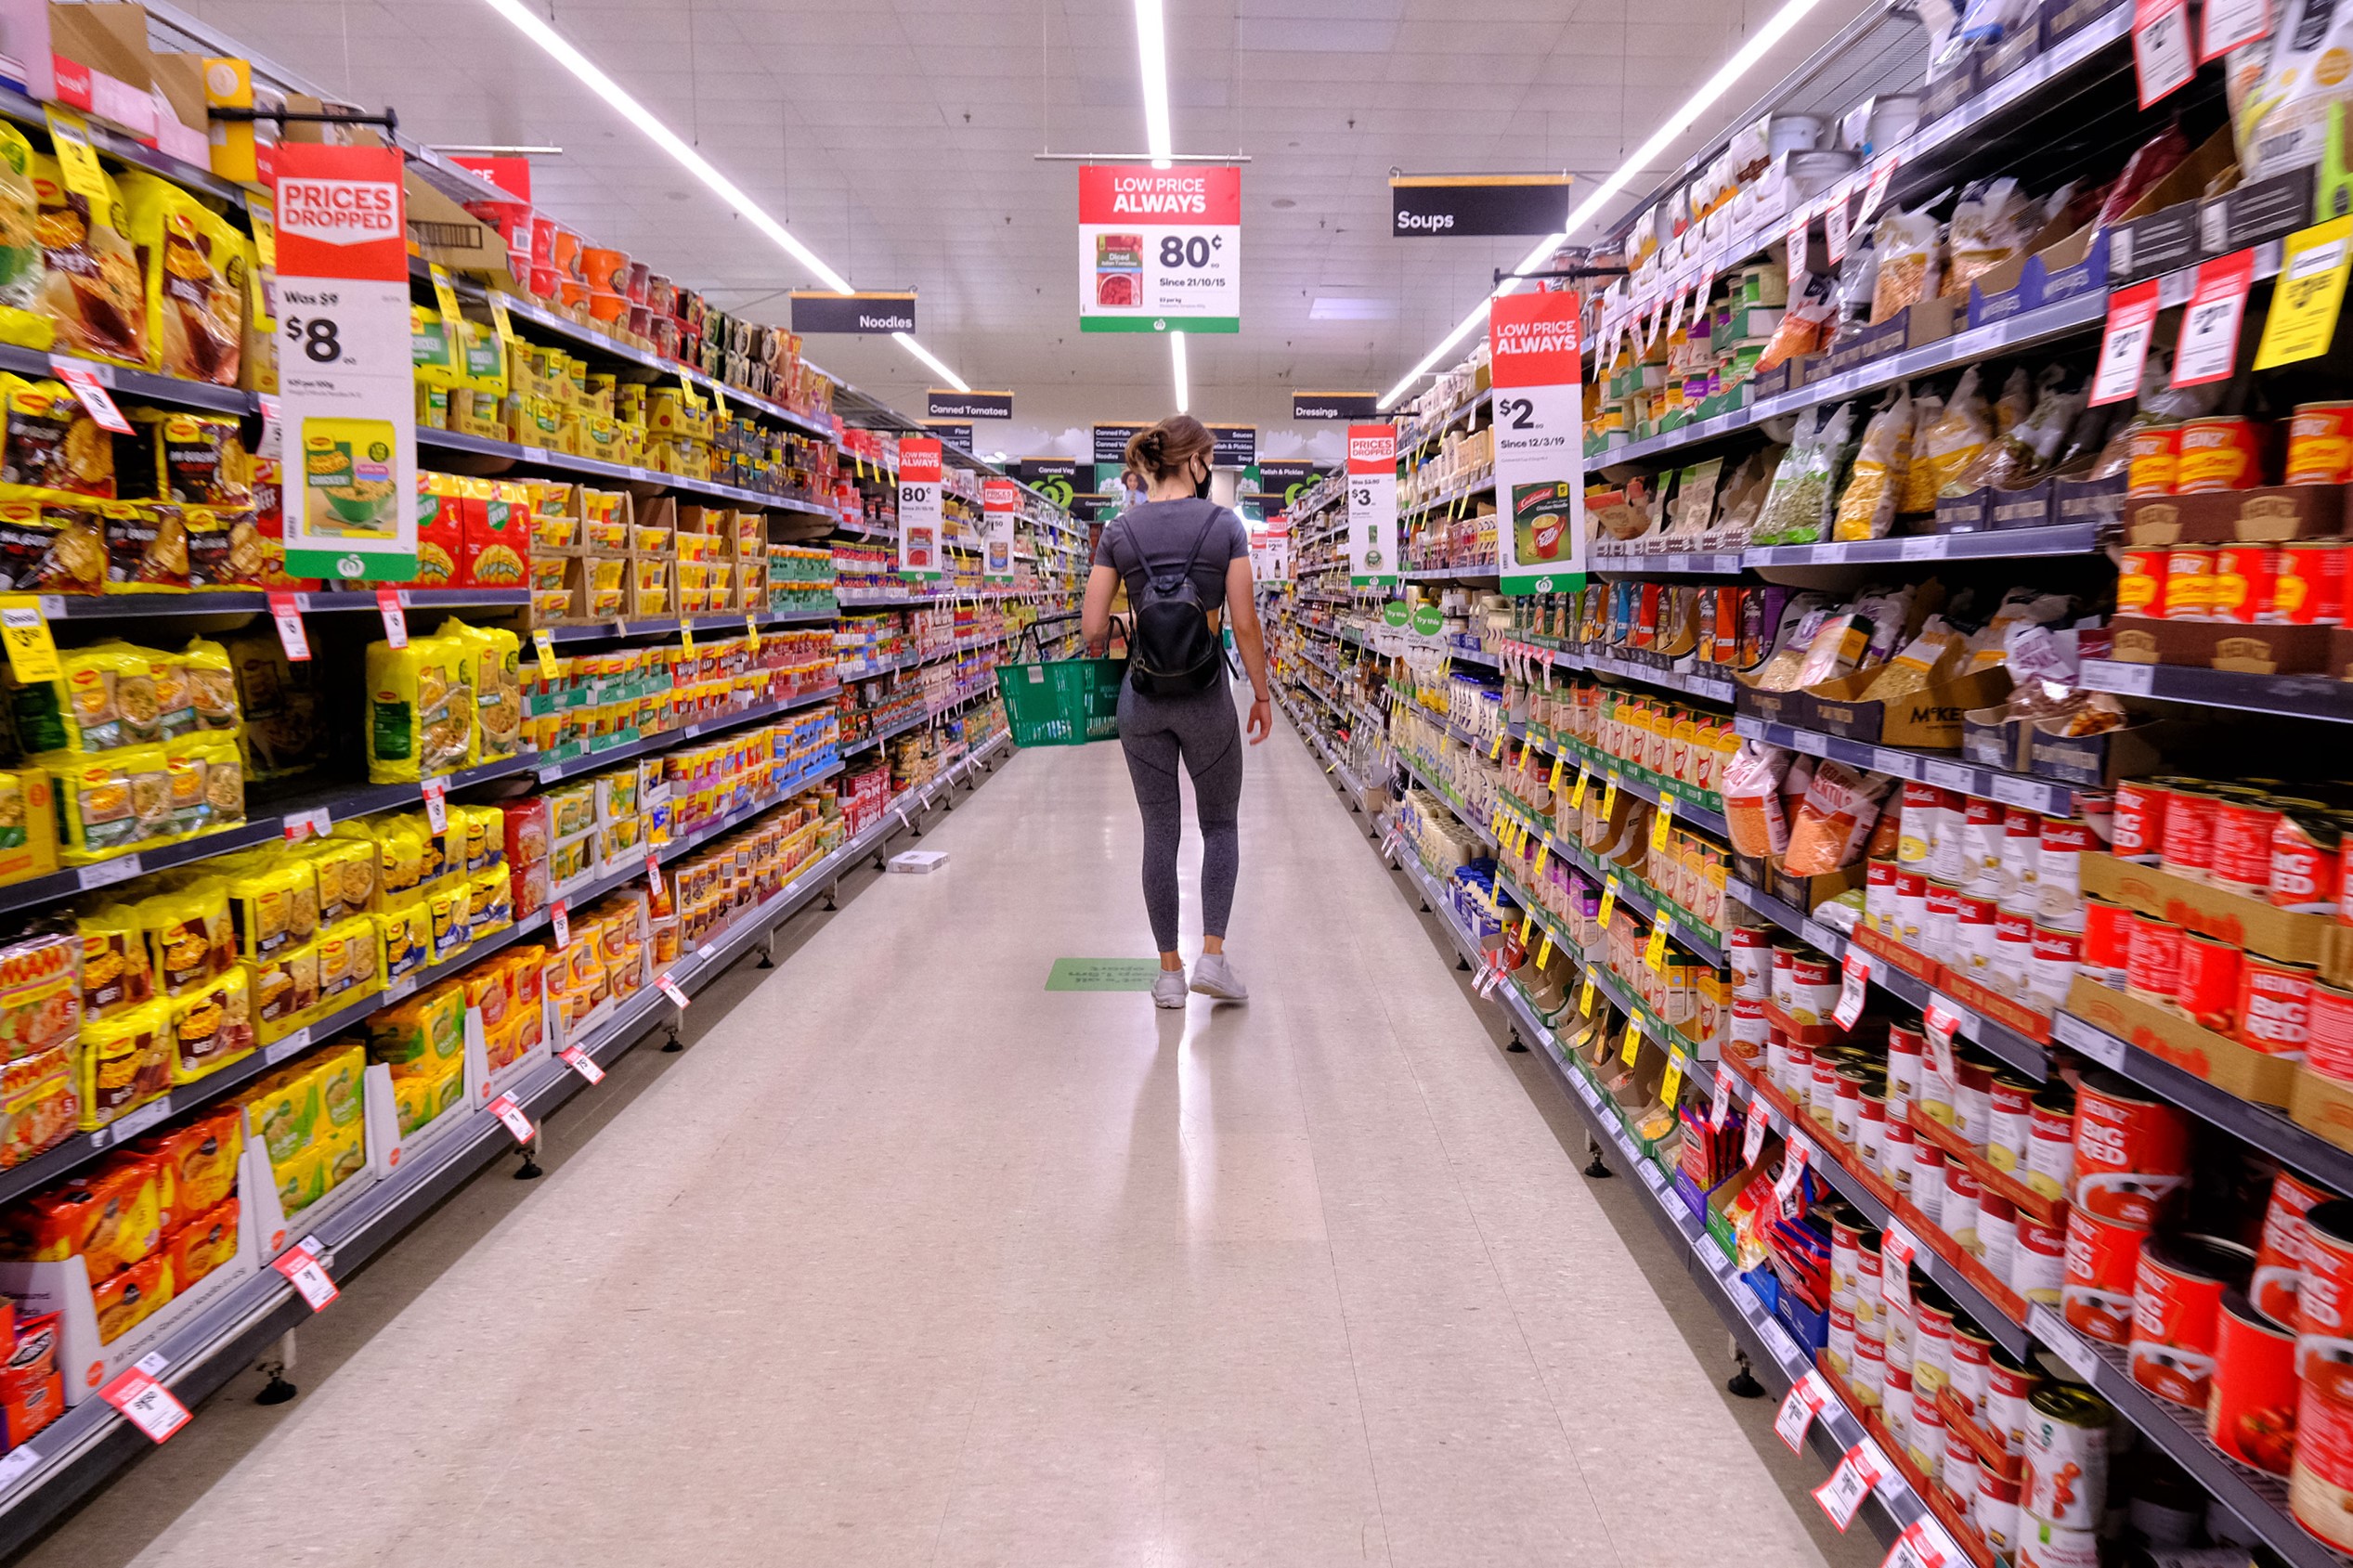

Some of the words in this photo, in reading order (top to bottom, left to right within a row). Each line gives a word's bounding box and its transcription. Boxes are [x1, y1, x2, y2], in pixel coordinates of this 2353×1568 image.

[1115, 177, 1153, 192] LOW
[1157, 178, 1205, 193] PRICE
[285, 185, 392, 212] PRICES
[1113, 194, 1206, 214] ALWAYS
[285, 209, 394, 230] DROPPED
[1398, 211, 1454, 232] Soups
[1109, 253, 1130, 262] Diced
[1160, 279, 1186, 287] Since
[1187, 278, 1226, 288] 21/10/15
[284, 291, 317, 305] Was
[860, 316, 913, 329] Noodles
[1497, 322, 1530, 337] LOW
[1533, 320, 1576, 335] PRICE
[285, 314, 342, 363] $8
[1496, 335, 1578, 355] ALWAYS
[930, 405, 964, 415] Canned
[966, 406, 1008, 416] Tomatoes
[1295, 407, 1338, 418] Dressings
[1499, 398, 1534, 430] $2
[1352, 440, 1392, 449] PRICES
[1501, 438, 1528, 449] Since
[1528, 436, 1566, 448] 12/3/19
[901, 459, 940, 467] ALWAYS
[1062, 467, 1074, 475] Veg
[1352, 488, 1372, 506] $3
[1386, 610, 1396, 618] Try
[1416, 616, 1428, 626] Try
[1428, 617, 1440, 626] this
[2252, 974, 2312, 999] HEINZ
[2251, 996, 2308, 1024] BIG
[2245, 1012, 2308, 1043] RED
[2082, 1097, 2129, 1125] HEINZ
[2080, 1116, 2126, 1148] BIG
[2077, 1133, 2127, 1166] RED
